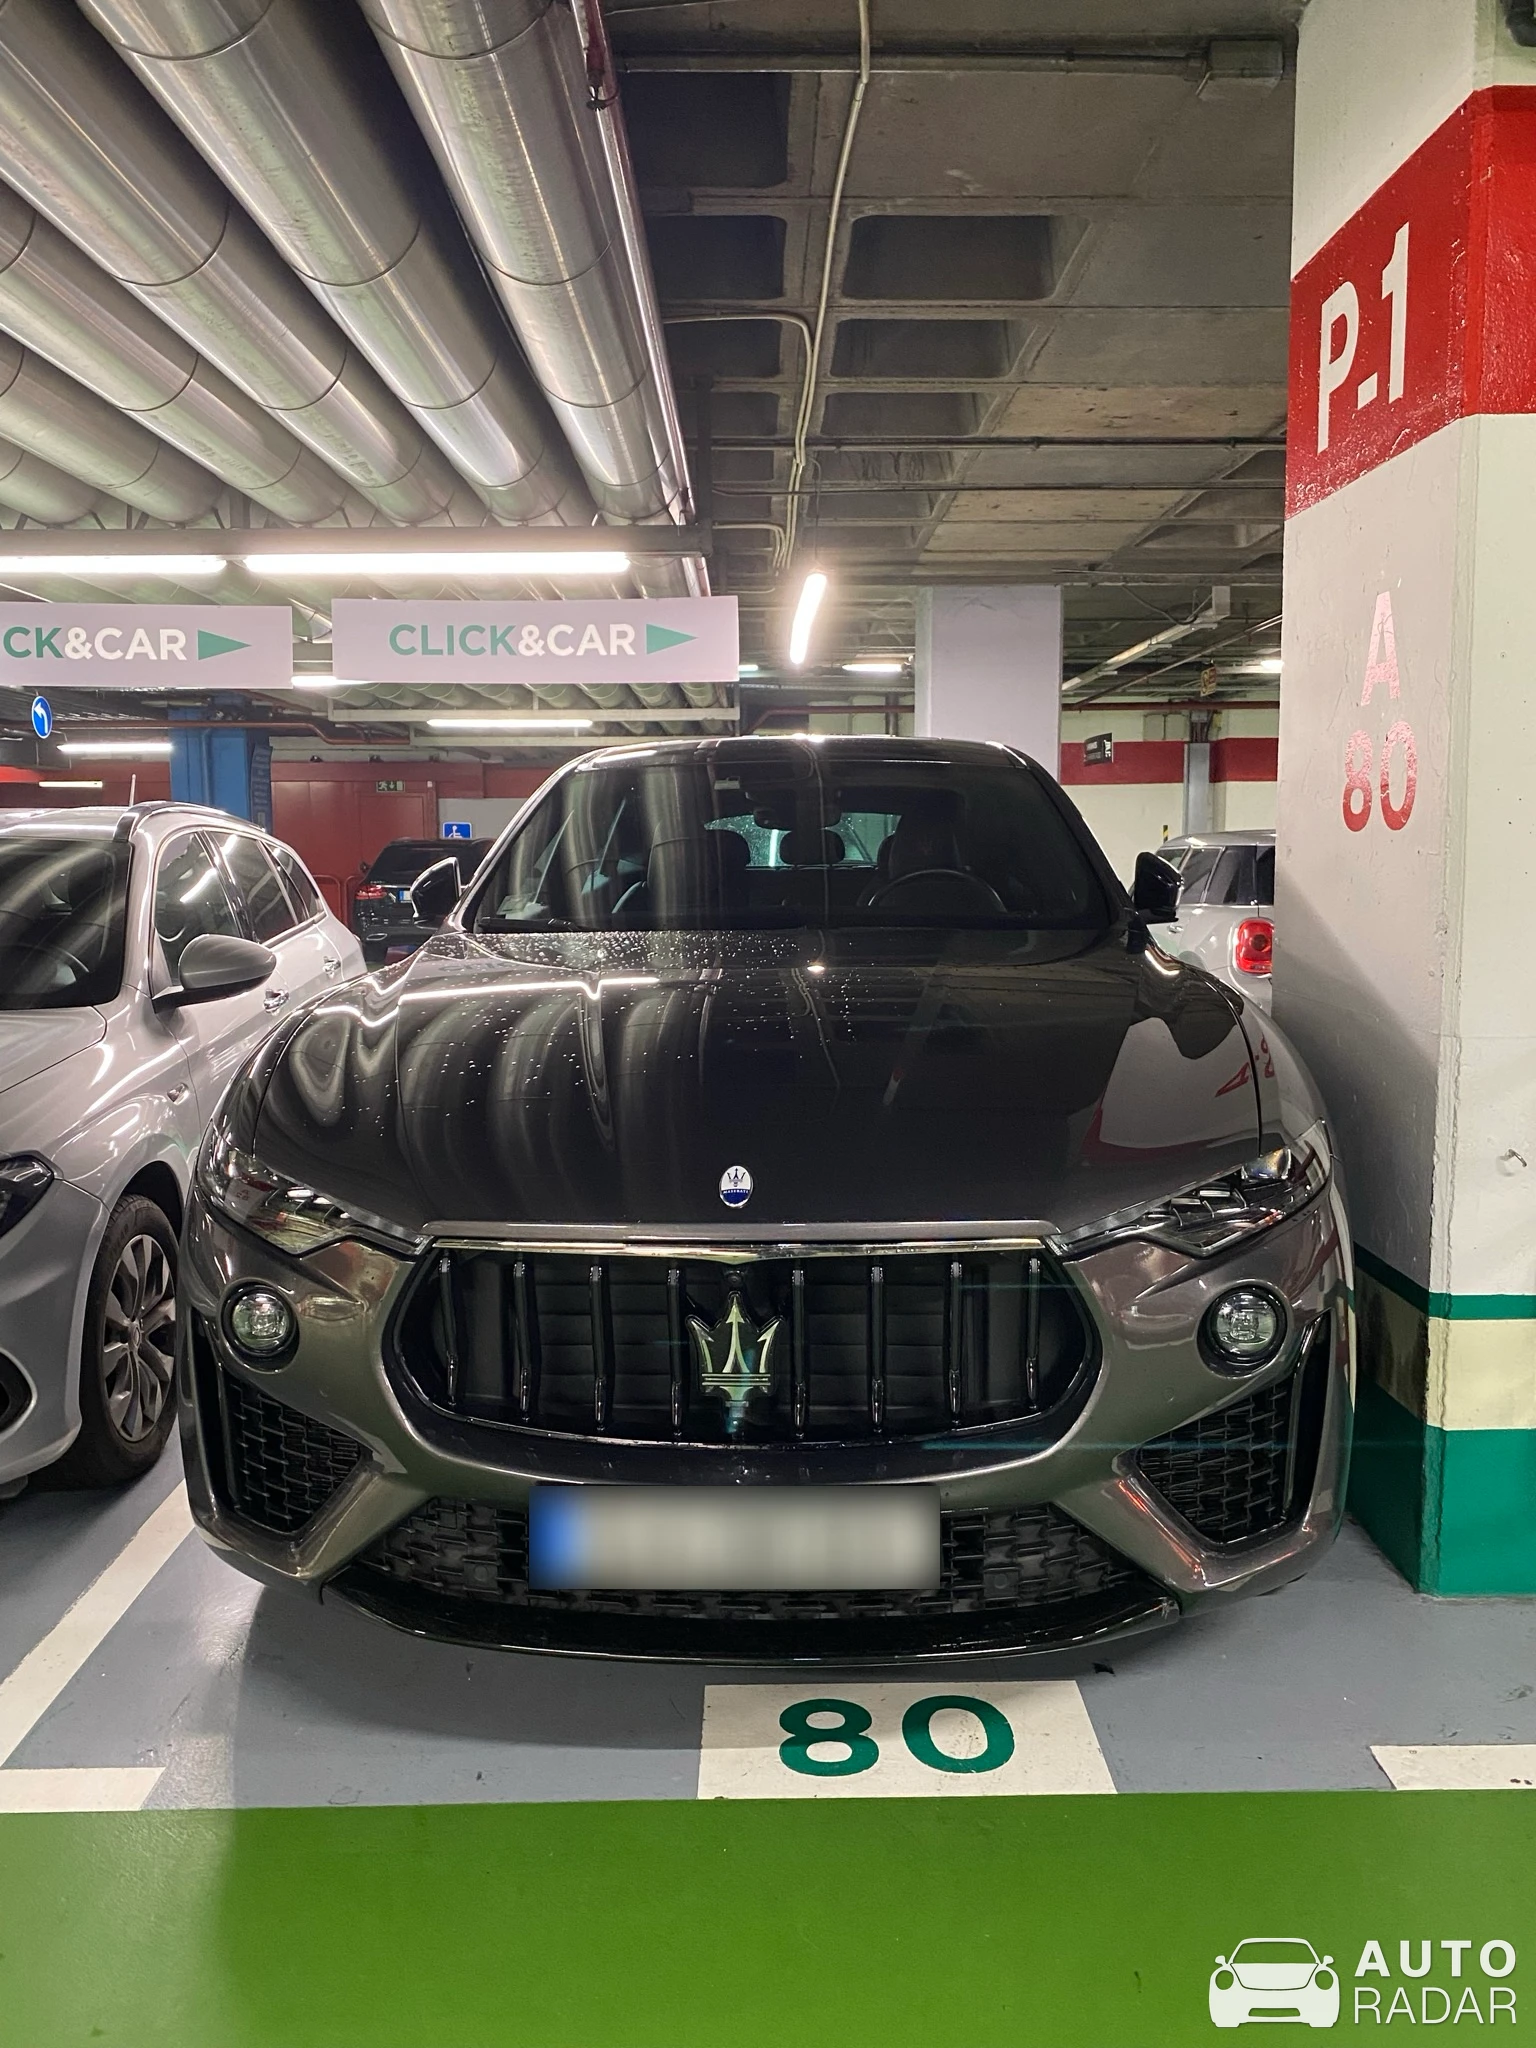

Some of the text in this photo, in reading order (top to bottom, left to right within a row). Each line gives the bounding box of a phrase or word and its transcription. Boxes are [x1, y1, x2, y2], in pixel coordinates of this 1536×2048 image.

[1317, 221, 1410, 455] P.1
[3, 626, 187, 661] CK&CAR
[388, 623, 636, 657] CLICK&CAR
[1361, 591, 1401, 706] A
[1342, 720, 1418, 832] 80
[779, 1694, 1015, 1777] 80
